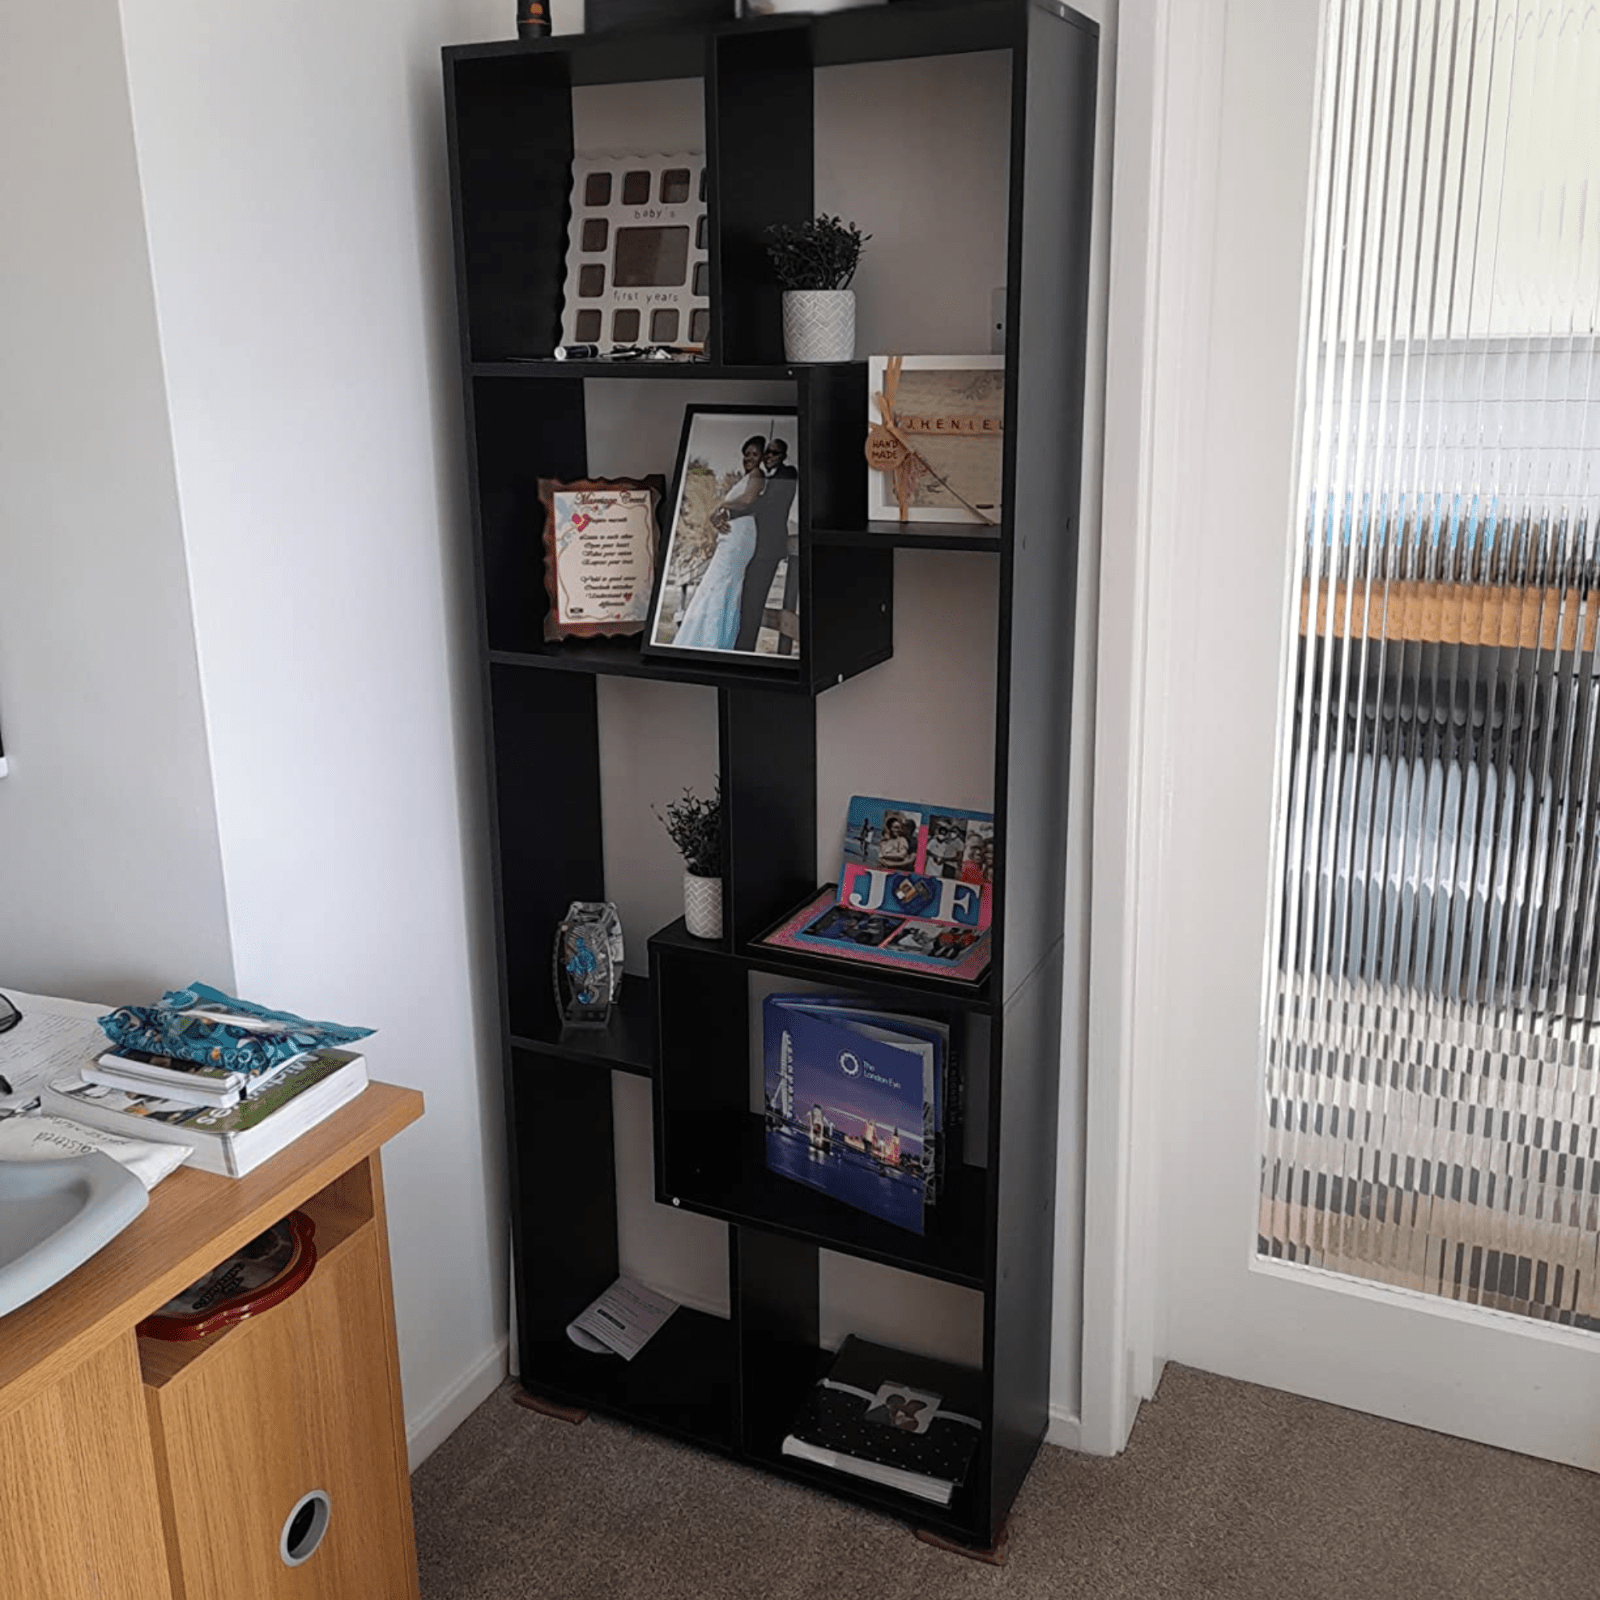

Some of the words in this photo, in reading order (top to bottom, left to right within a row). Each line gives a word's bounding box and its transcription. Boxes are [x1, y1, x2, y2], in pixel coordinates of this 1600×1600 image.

[613, 289, 639, 301] first
[646, 293, 679, 305] years
[872, 439, 900, 449] HAND
[871, 450, 898, 460] MADE
[849, 868, 889, 910] J
[931, 877, 982, 924] F
[863, 1060, 876, 1073] The
[863, 1069, 888, 1085] London
[888, 1077, 902, 1090] Eye
